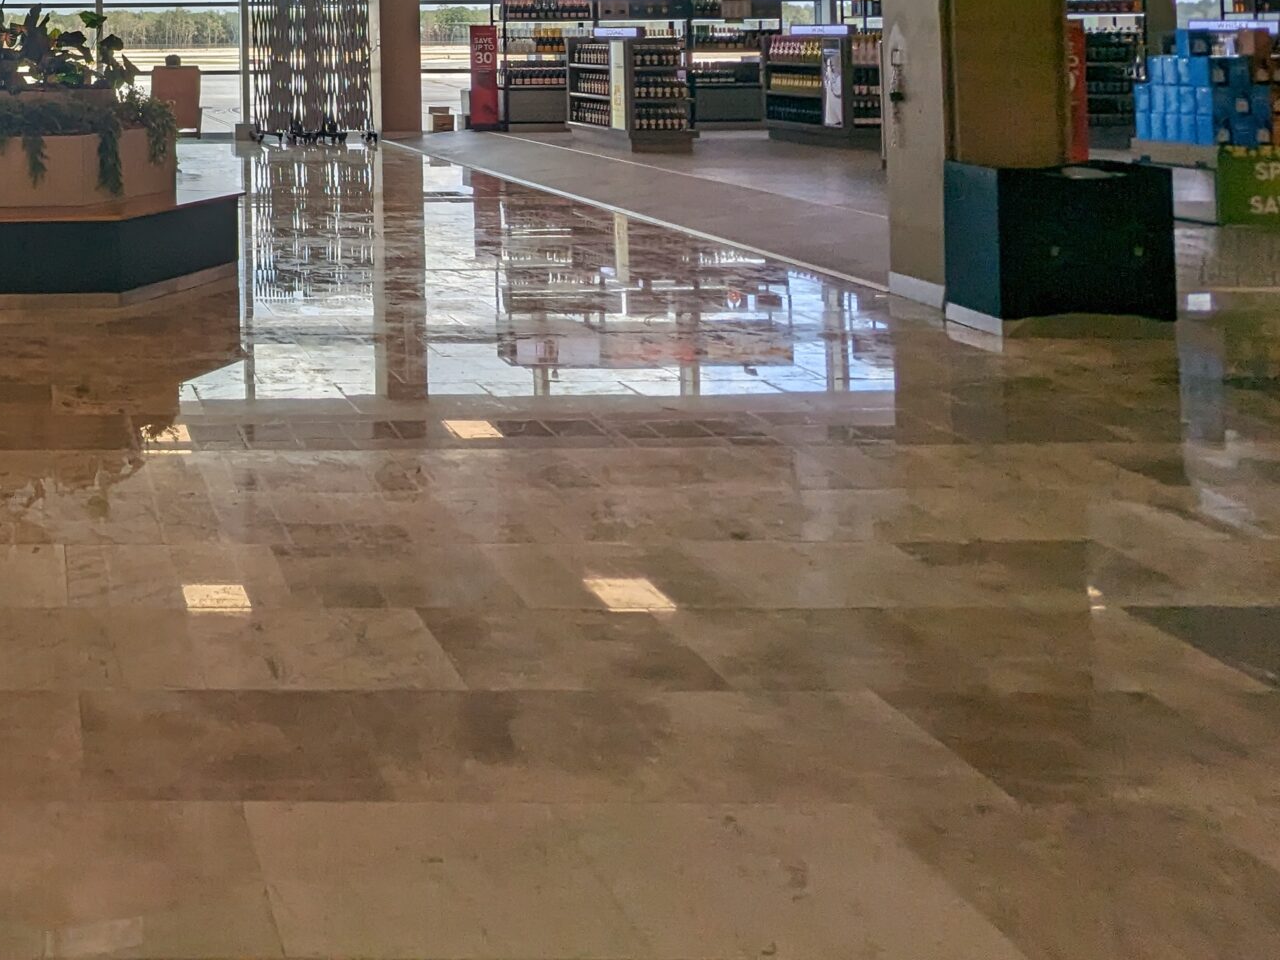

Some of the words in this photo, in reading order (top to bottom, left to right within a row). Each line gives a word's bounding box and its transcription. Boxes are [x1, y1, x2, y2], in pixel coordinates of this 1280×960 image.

[472, 43, 483, 51] UP
[484, 43, 495, 51] TO
[475, 51, 493, 64] 30
